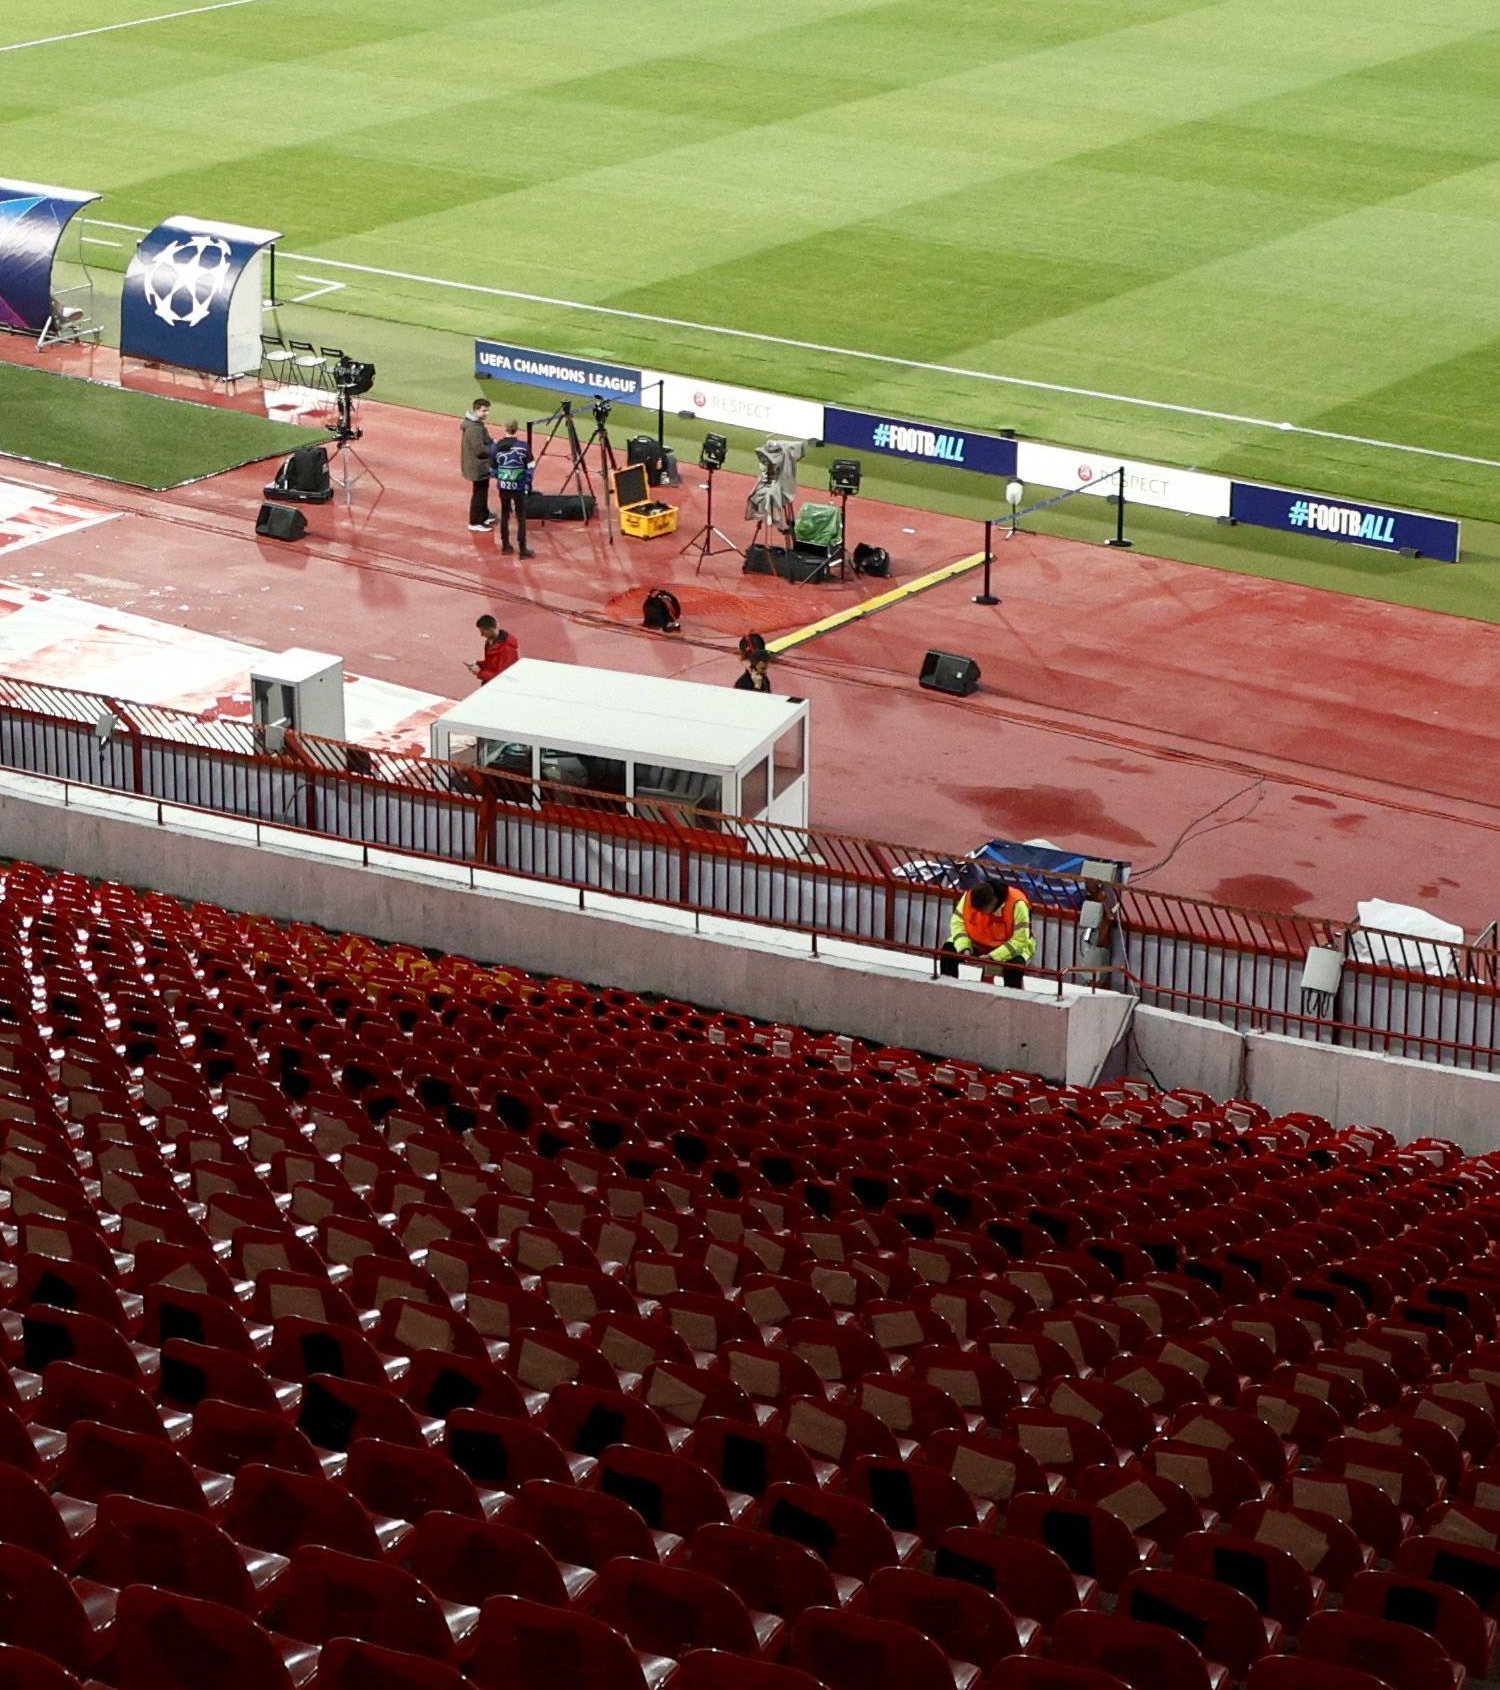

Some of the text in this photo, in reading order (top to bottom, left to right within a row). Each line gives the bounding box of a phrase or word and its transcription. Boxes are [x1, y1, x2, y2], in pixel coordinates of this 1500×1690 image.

[479, 351, 637, 394] UEFA CHAMPIONS LEAGUE
[712, 397, 772, 420] RESPECT
[872, 422, 965, 463] #FOOTBALL
[1288, 499, 1396, 545] #FOOTBALL
